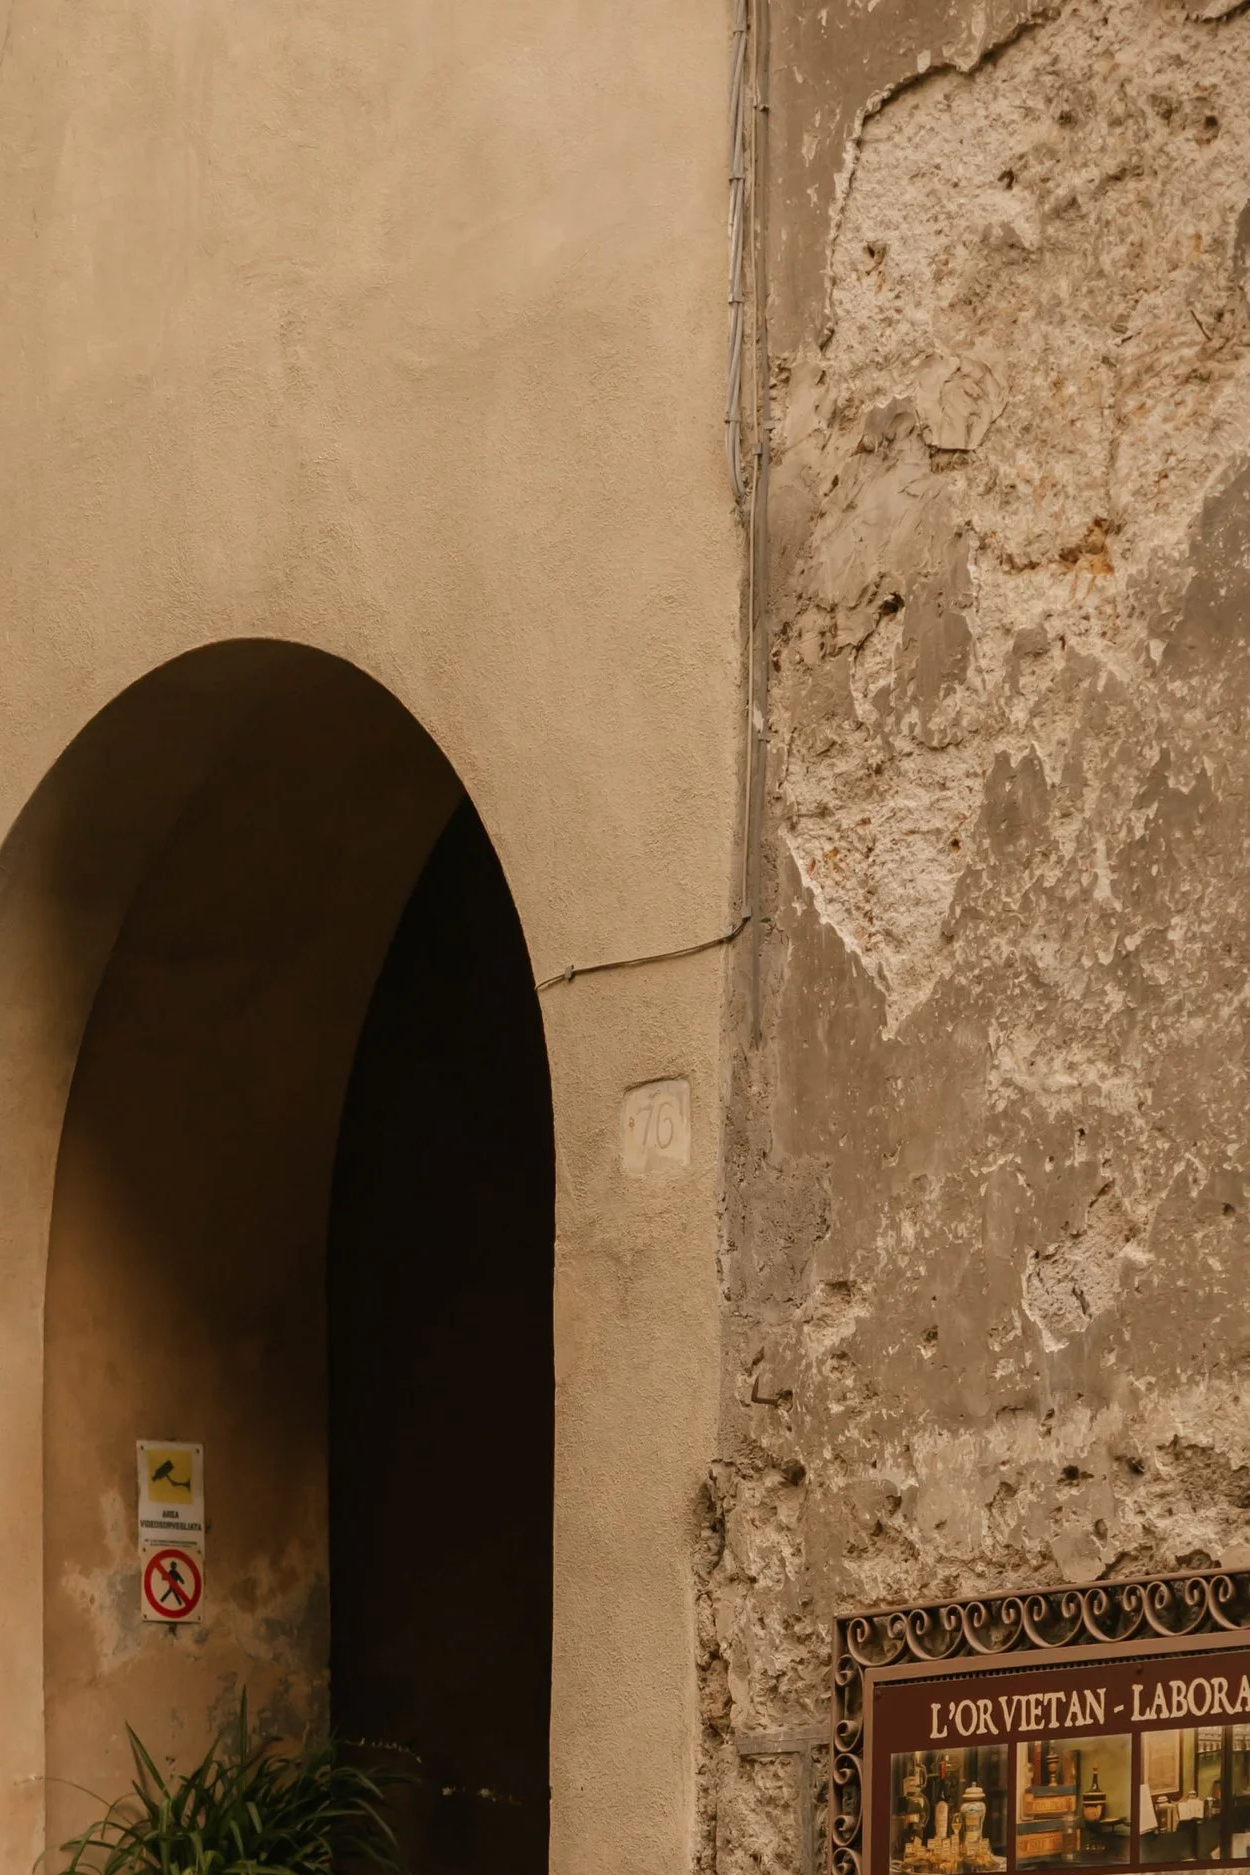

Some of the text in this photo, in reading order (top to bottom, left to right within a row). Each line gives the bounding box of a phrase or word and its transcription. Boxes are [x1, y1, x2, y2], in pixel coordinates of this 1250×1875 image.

[636, 1101, 675, 1150] 76
[930, 1688, 1107, 1739] L'ORVIETAN
[1131, 1675, 1250, 1722] LABORA
